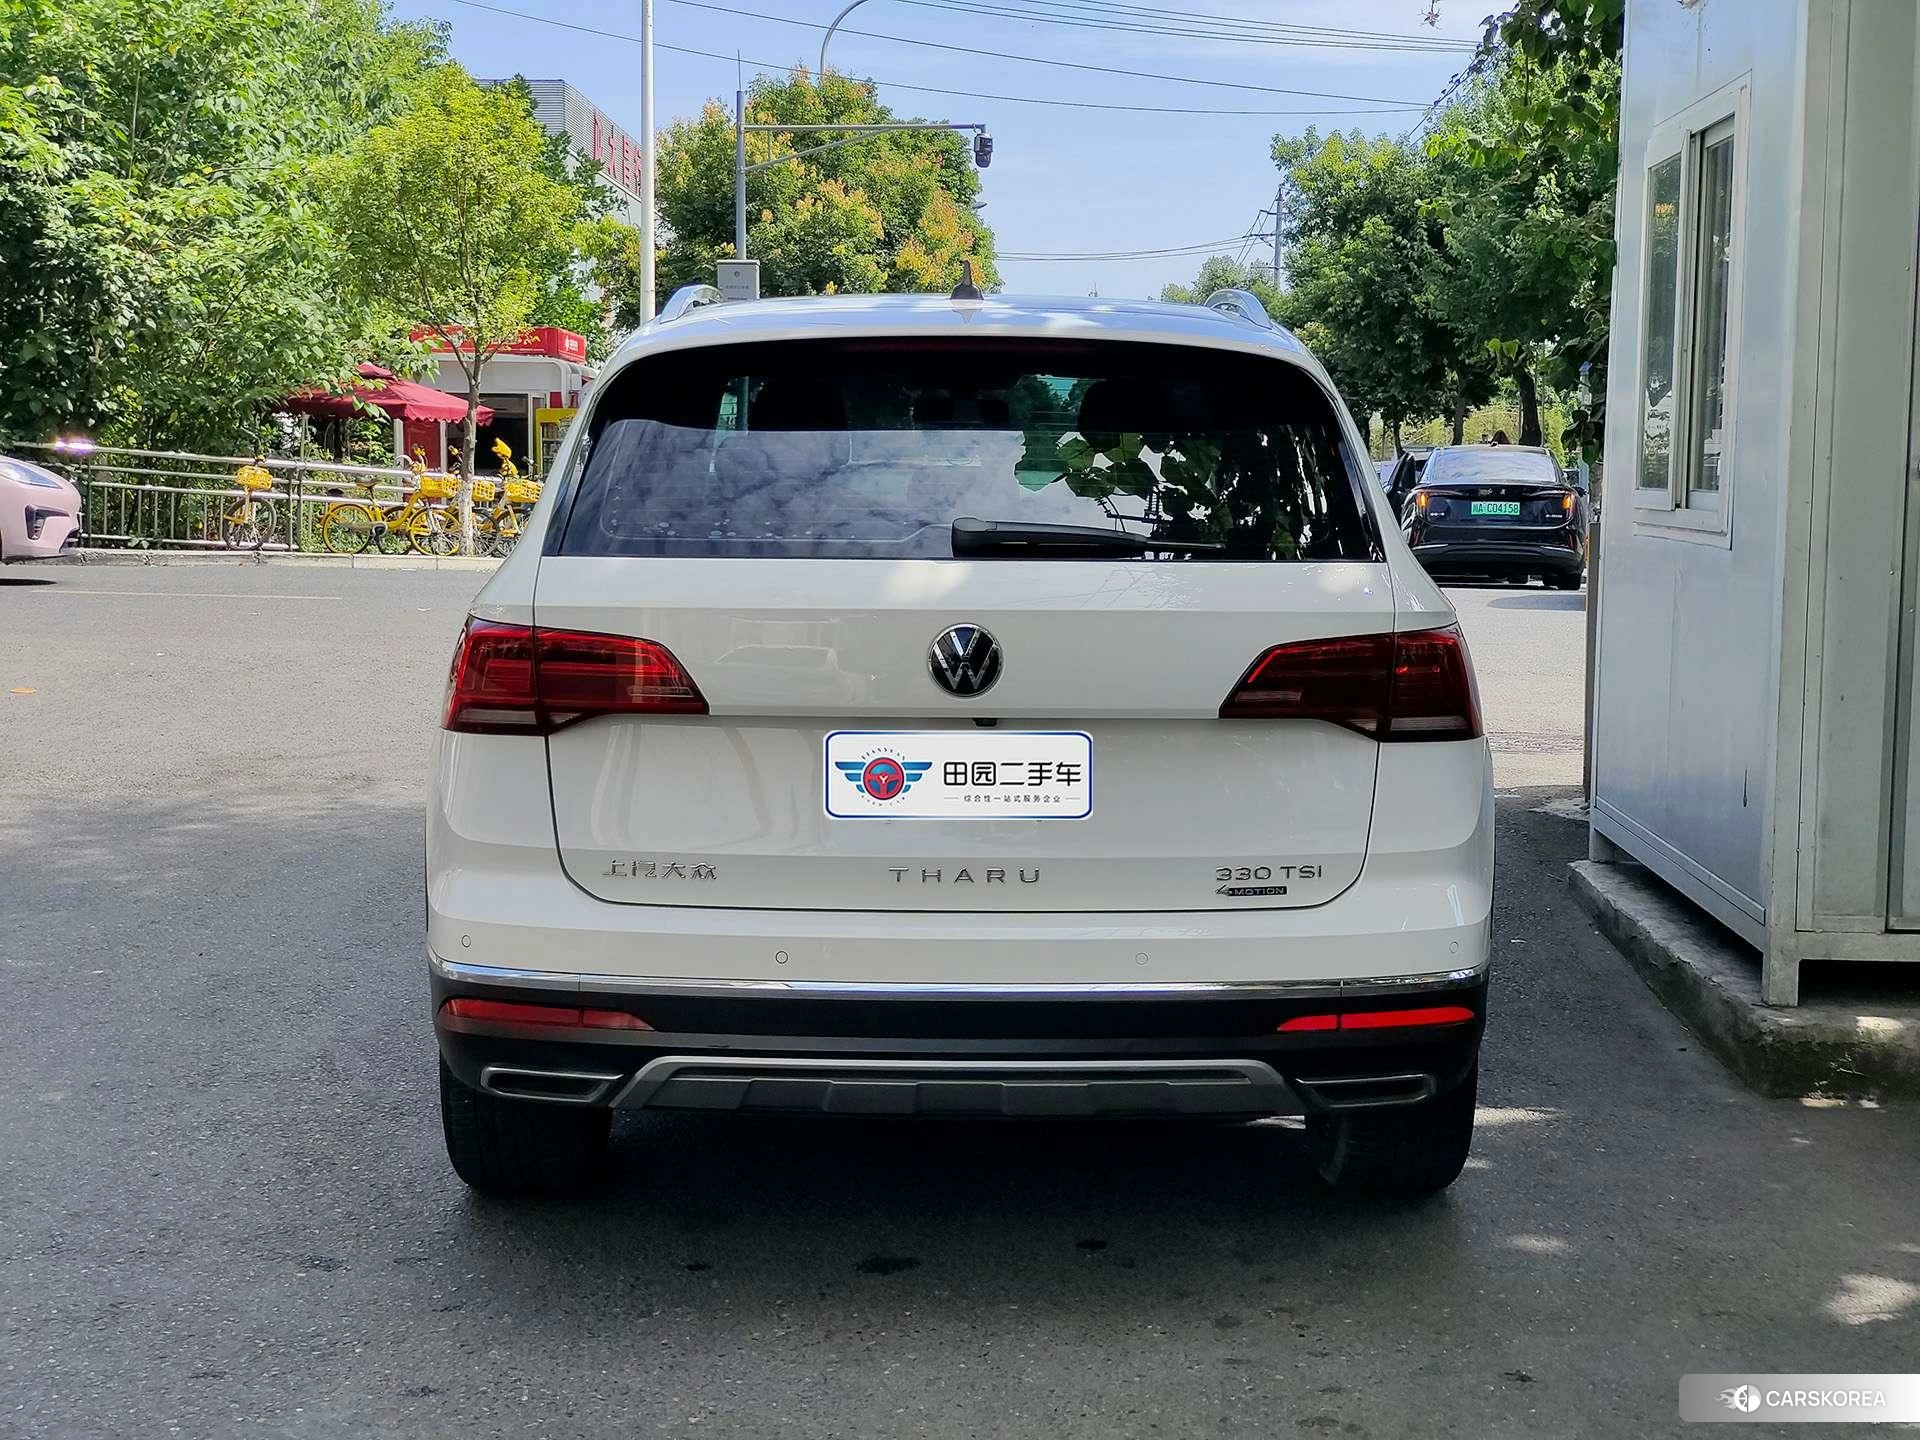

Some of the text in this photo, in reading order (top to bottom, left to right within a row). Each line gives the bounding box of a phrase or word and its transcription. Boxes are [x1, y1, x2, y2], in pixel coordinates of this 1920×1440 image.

[943, 761, 1082, 787] 田园二手车
[963, 794, 1061, 804] 综合性一站式服务企业
[888, 866, 1041, 884] THARU
[1215, 864, 1323, 881] 330 TSI
